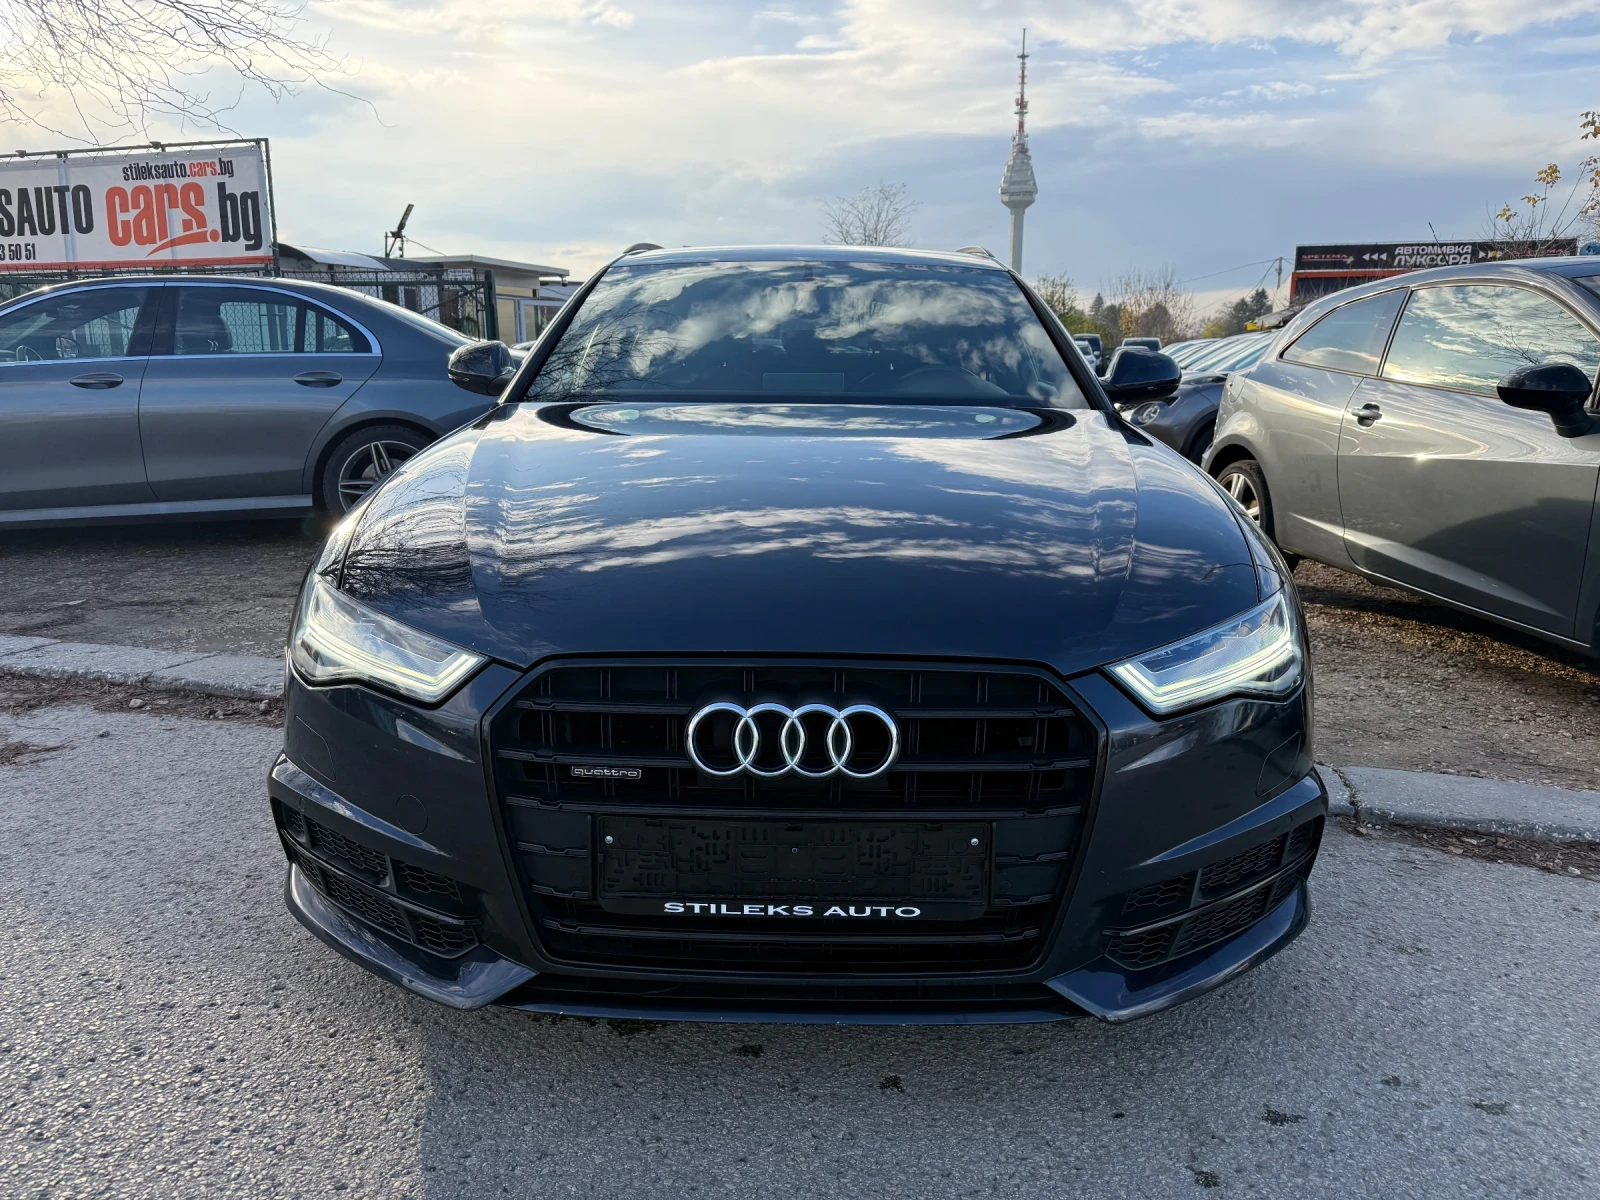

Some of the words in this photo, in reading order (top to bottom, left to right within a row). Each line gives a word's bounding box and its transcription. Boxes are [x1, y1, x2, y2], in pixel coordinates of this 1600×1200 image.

[122, 157, 234, 181] stileksauto.cars.bg
[105, 181, 263, 252] cars.bg
[8, 243, 22, 261] 50
[24, 243, 36, 260] 51
[1394, 245, 1472, 255] АВТОМИВКА
[1393, 254, 1471, 265] ЛУКСОРА
[574, 768, 638, 777] quattro
[663, 901, 814, 918] STILEKS
[822, 904, 922, 919] AUTO
